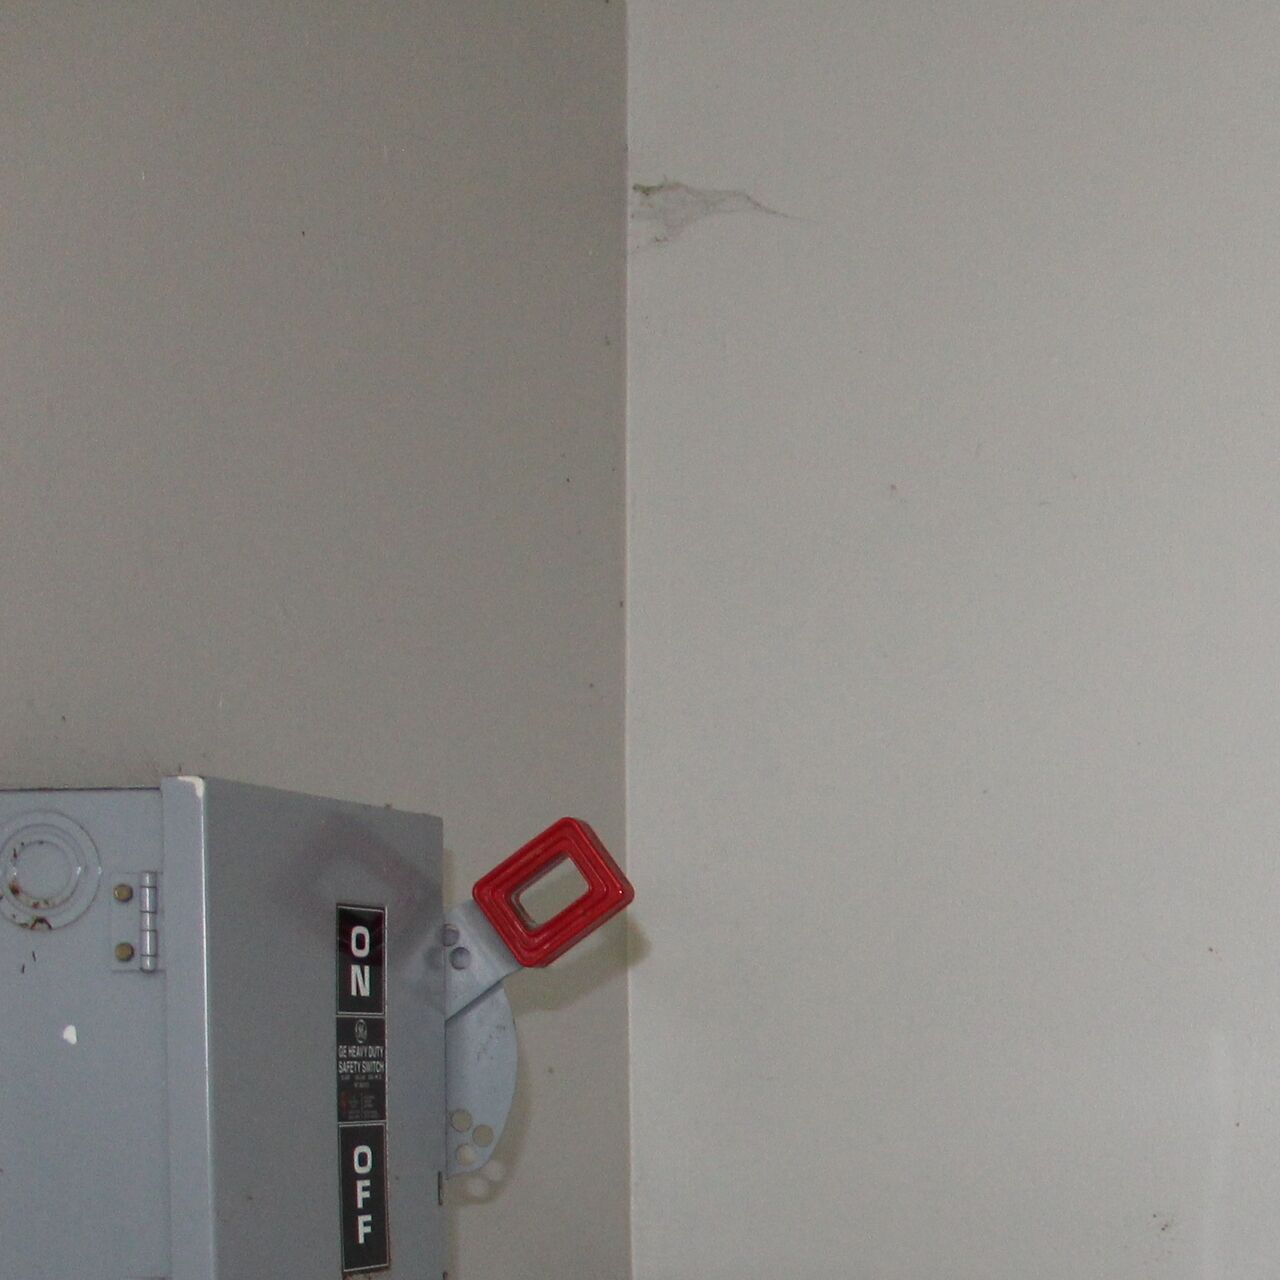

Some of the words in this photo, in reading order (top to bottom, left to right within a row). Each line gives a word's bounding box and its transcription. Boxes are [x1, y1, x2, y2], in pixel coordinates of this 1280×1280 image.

[350, 925, 370, 997] ON
[338, 1060, 361, 1073] SAFETY
[362, 1060, 385, 1073] SWITCH
[348, 1045, 367, 1058] HEAVY
[368, 1045, 385, 1058] DUTY
[353, 1145, 373, 1245] OFF
